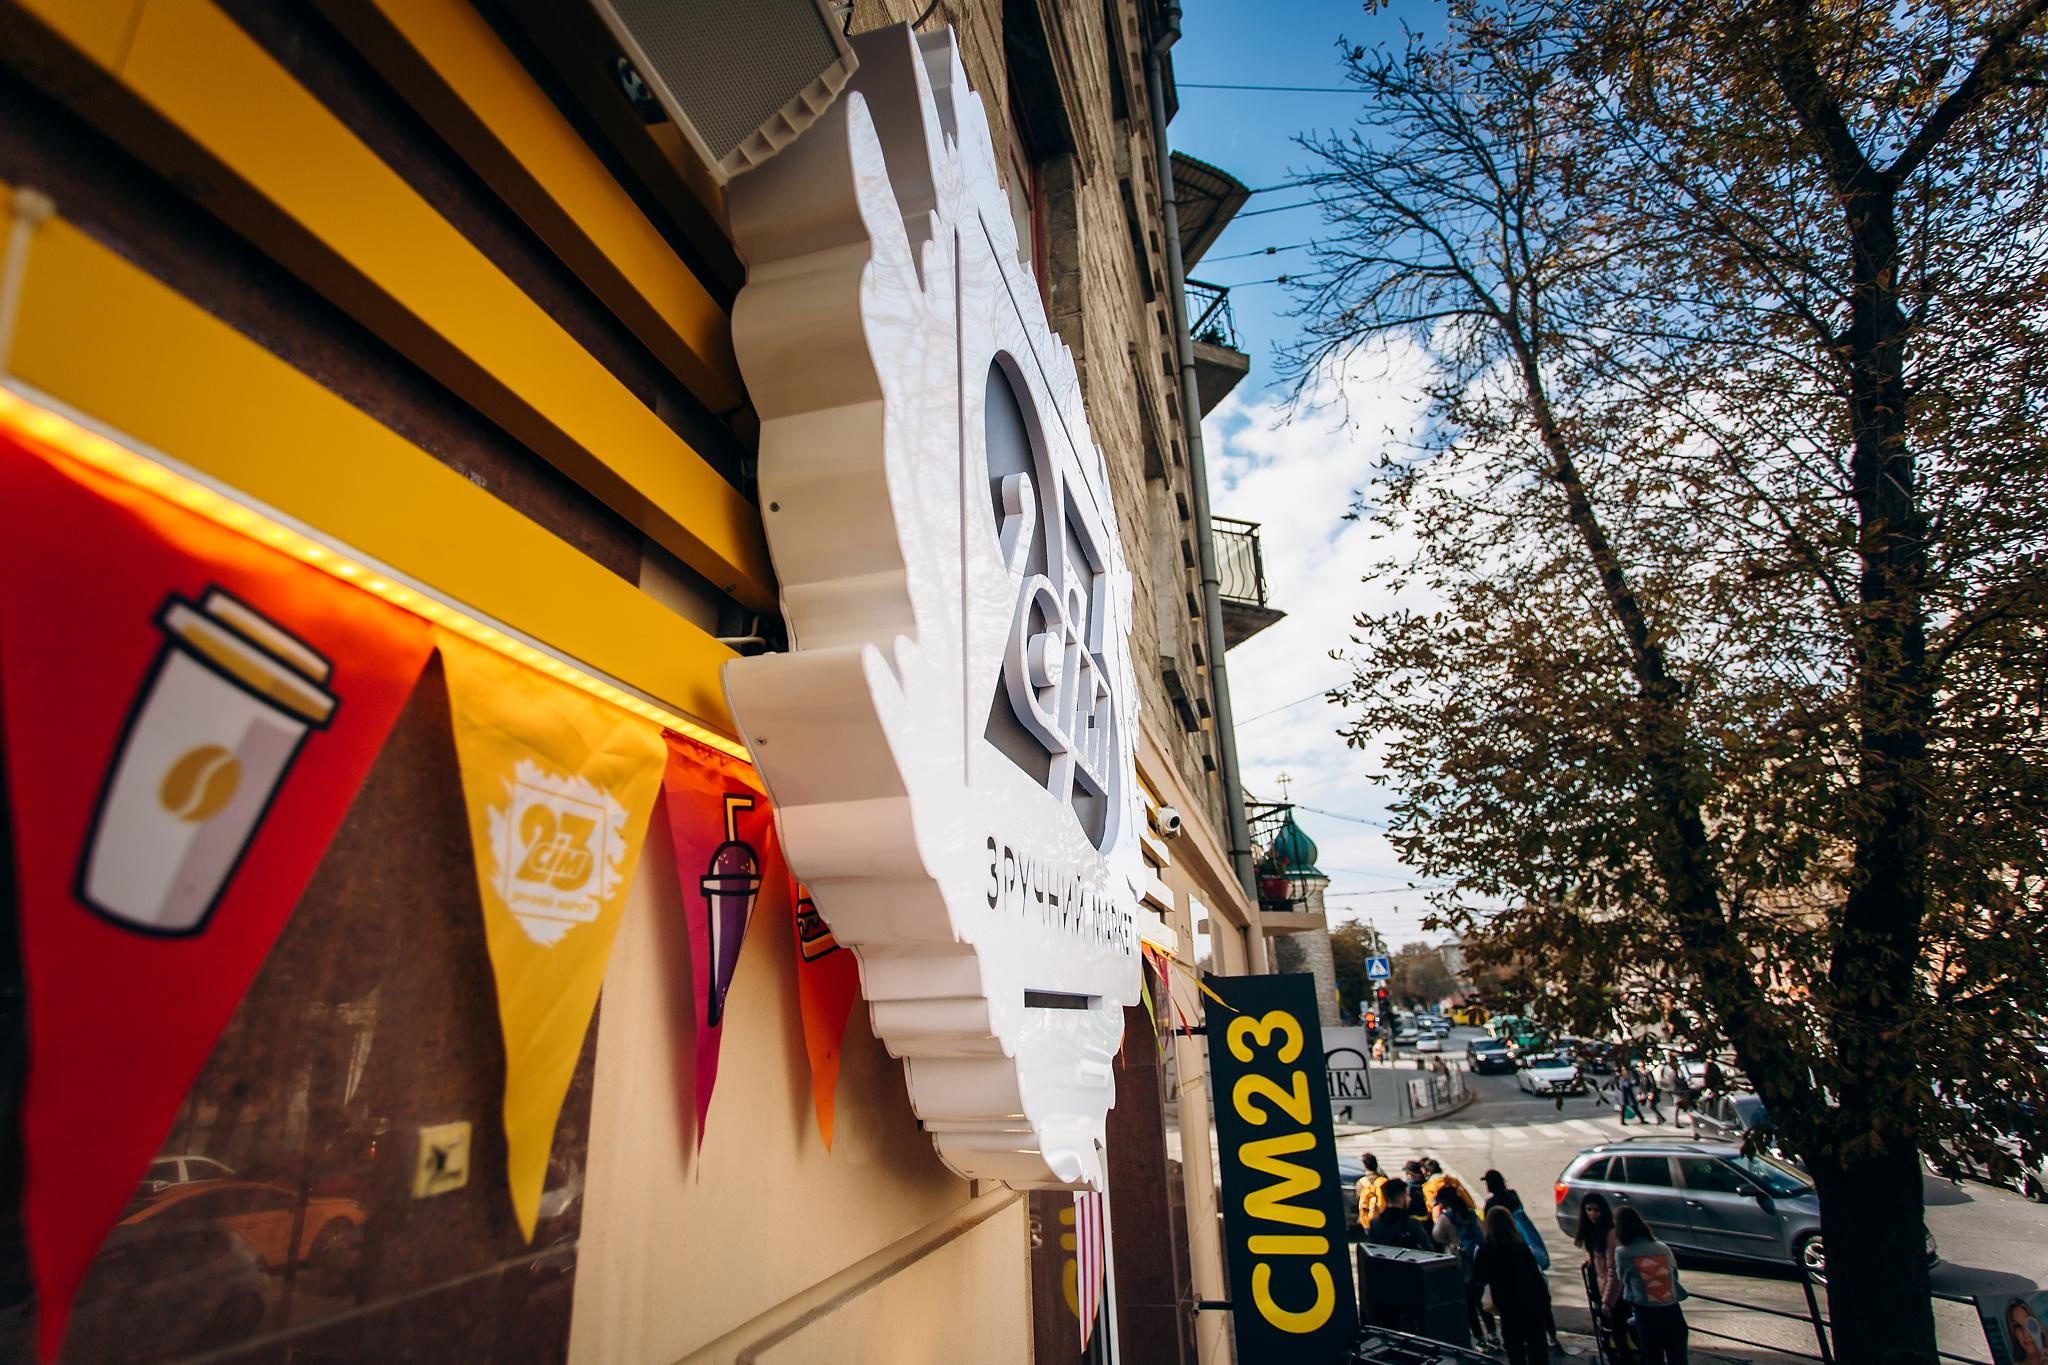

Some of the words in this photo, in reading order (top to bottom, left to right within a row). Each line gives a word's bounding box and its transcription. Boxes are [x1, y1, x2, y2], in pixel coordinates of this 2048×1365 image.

[515, 803, 597, 892] 23
[987, 836, 1086, 941] ЗРУЧНИЙ
[1226, 1009, 1336, 1334] СІМ23
